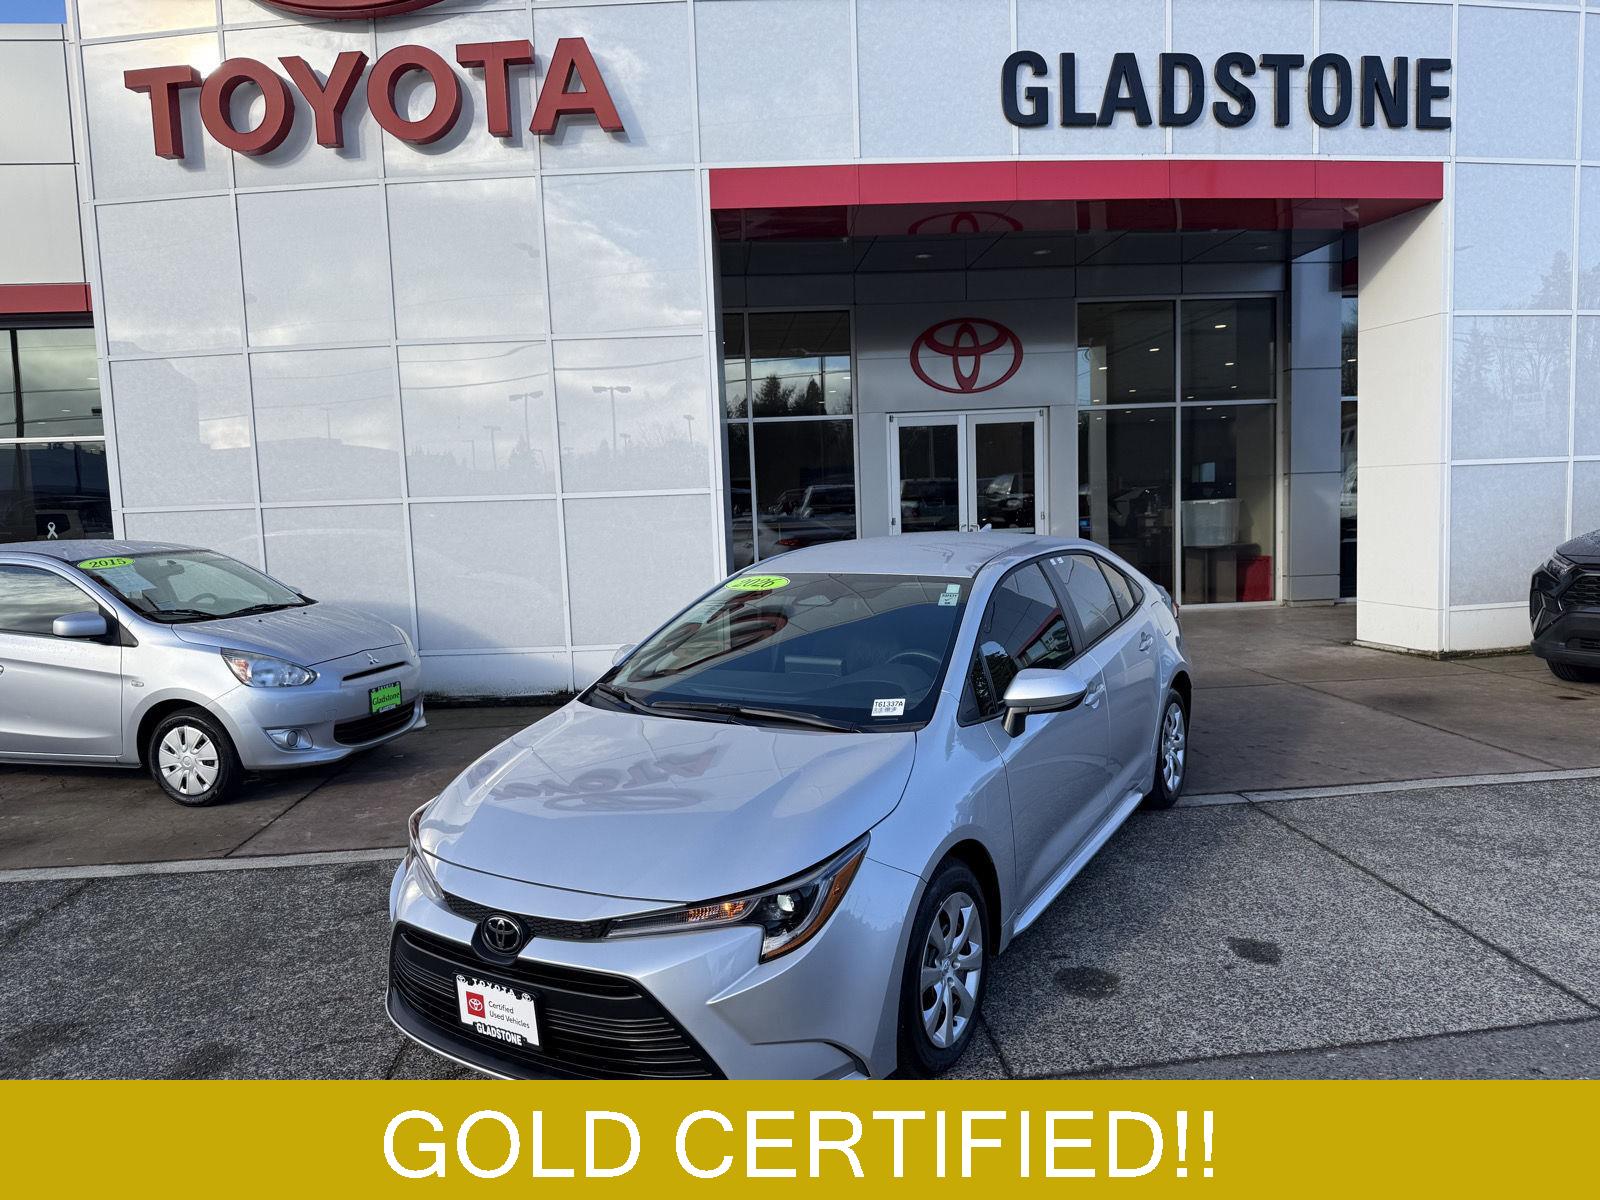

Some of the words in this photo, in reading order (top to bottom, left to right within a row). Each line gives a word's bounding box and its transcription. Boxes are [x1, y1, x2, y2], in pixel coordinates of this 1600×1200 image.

[124, 37, 624, 159] TOYOTA
[1001, 51, 1452, 130] GLADSTONE
[89, 558, 126, 567] 2015
[373, 692, 400, 705] Gladstone
[471, 978, 515, 996] TOYOTA
[488, 1001, 514, 1014] Certified
[489, 1011, 505, 1021] Used
[505, 1016, 530, 1029] Vehicles
[476, 1022, 523, 1046] GLADSTONE
